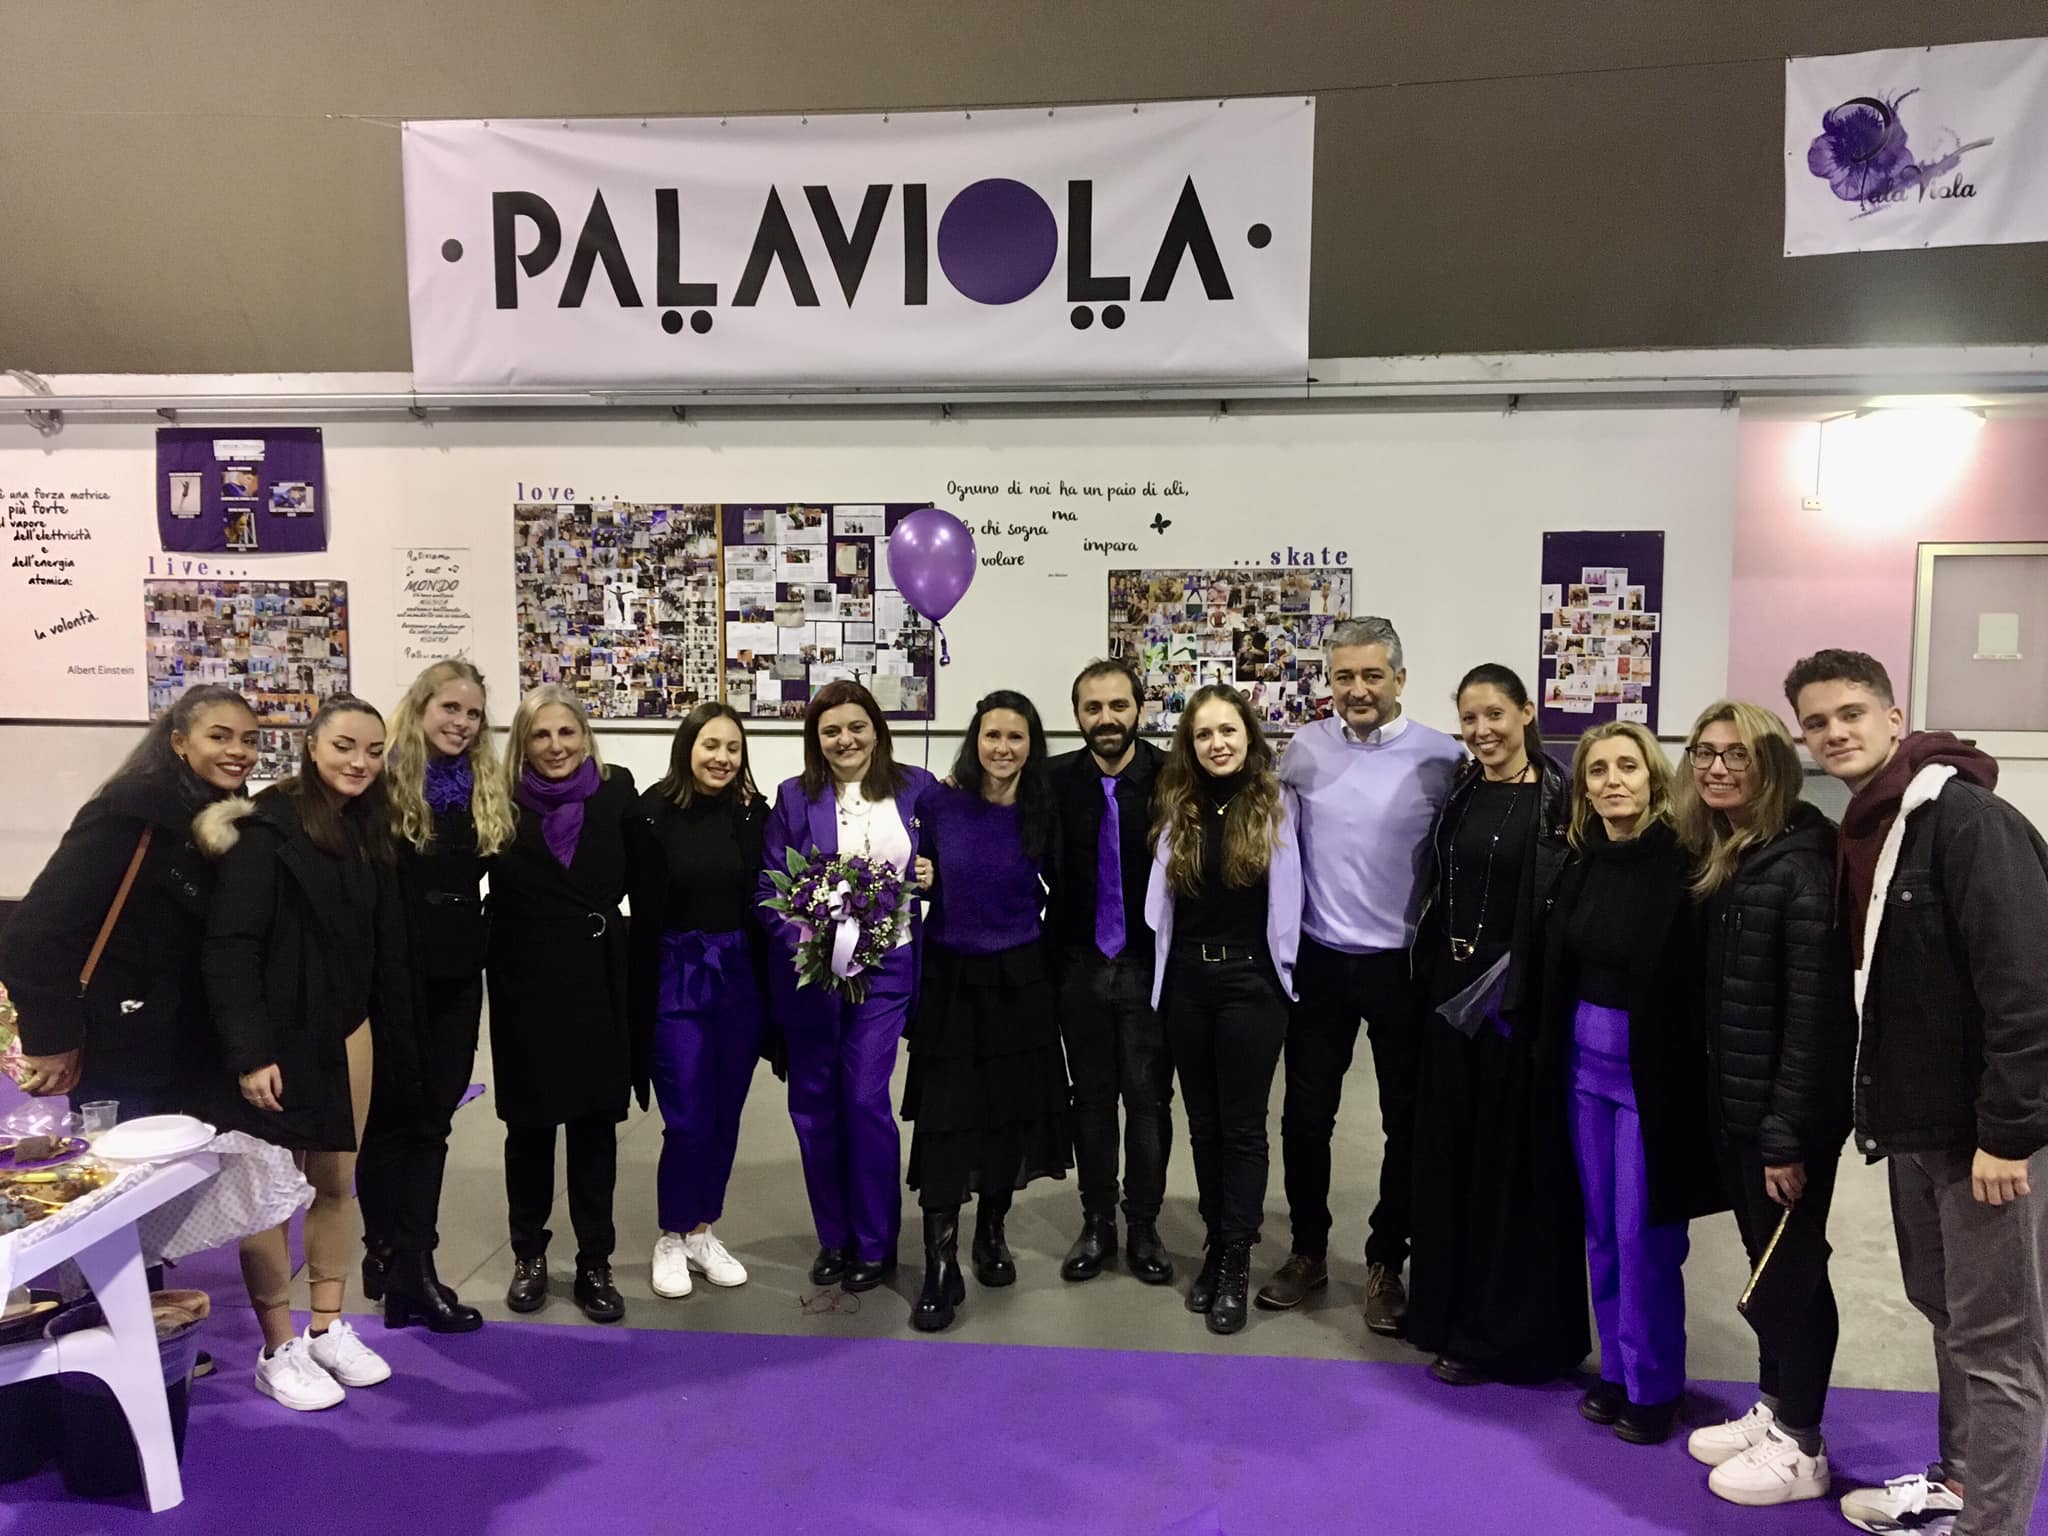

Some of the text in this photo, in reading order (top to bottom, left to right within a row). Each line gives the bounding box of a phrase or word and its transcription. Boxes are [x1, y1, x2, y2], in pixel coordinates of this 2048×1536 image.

[492, 174, 1234, 333] PALAVIOLA
[10, 491, 29, 500] una
[34, 487, 65, 500] forza
[70, 488, 111, 500] motrice
[517, 481, 575, 501] love
[946, 480, 1190, 502] Ognuno di noi ha un paio di ali,
[8, 500, 69, 520] più forte
[1051, 510, 1079, 521] ma
[10, 520, 47, 528] vapore
[980, 520, 1002, 536] chi
[1007, 522, 1049, 542] sogna
[41, 546, 48, 554] e
[1083, 537, 1139, 557] impara
[12, 554, 76, 572] dell'energia
[981, 550, 1025, 567] volare
[404, 579, 461, 593] MONDO
[34, 628, 47, 641] la
[67, 665, 135, 675] Albert Einstein
